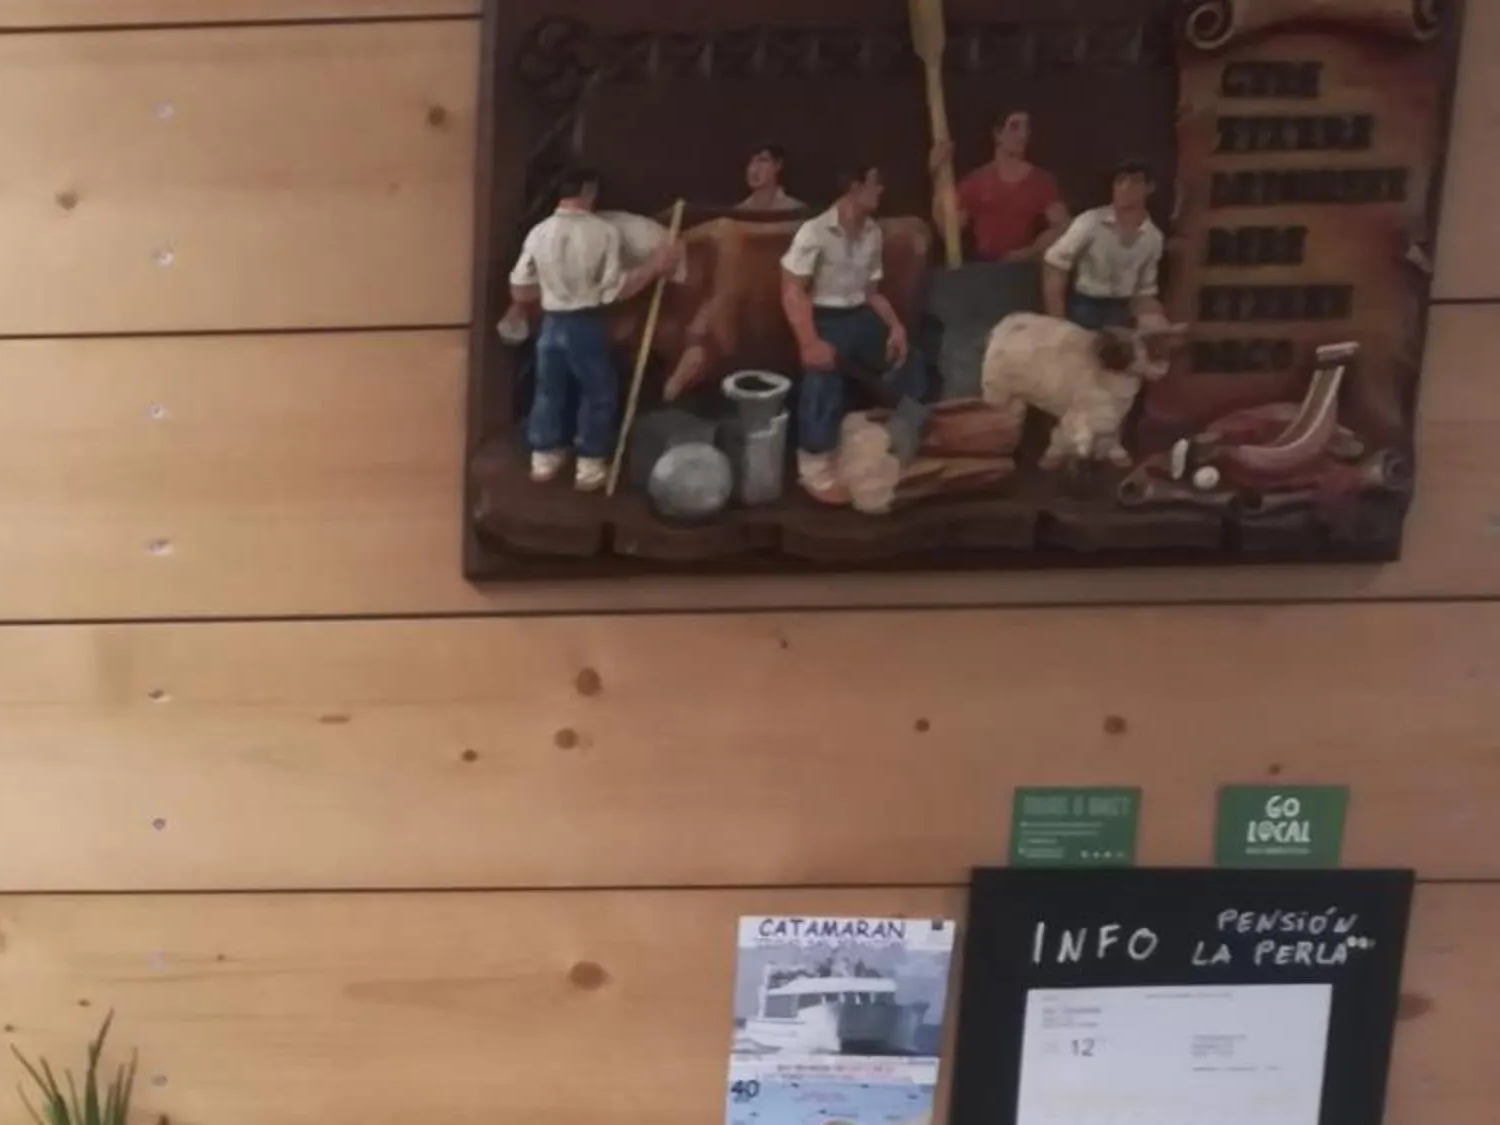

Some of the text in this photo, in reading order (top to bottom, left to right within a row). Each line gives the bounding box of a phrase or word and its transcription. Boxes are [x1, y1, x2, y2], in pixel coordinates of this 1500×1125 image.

[1265, 795, 1301, 819] GO
[1246, 820, 1311, 843] LOCAL
[758, 917, 906, 939] CATAMARAN
[1031, 920, 1159, 965] INFO
[1191, 940, 1232, 966] LA
[1071, 1037, 1095, 1057] 12
